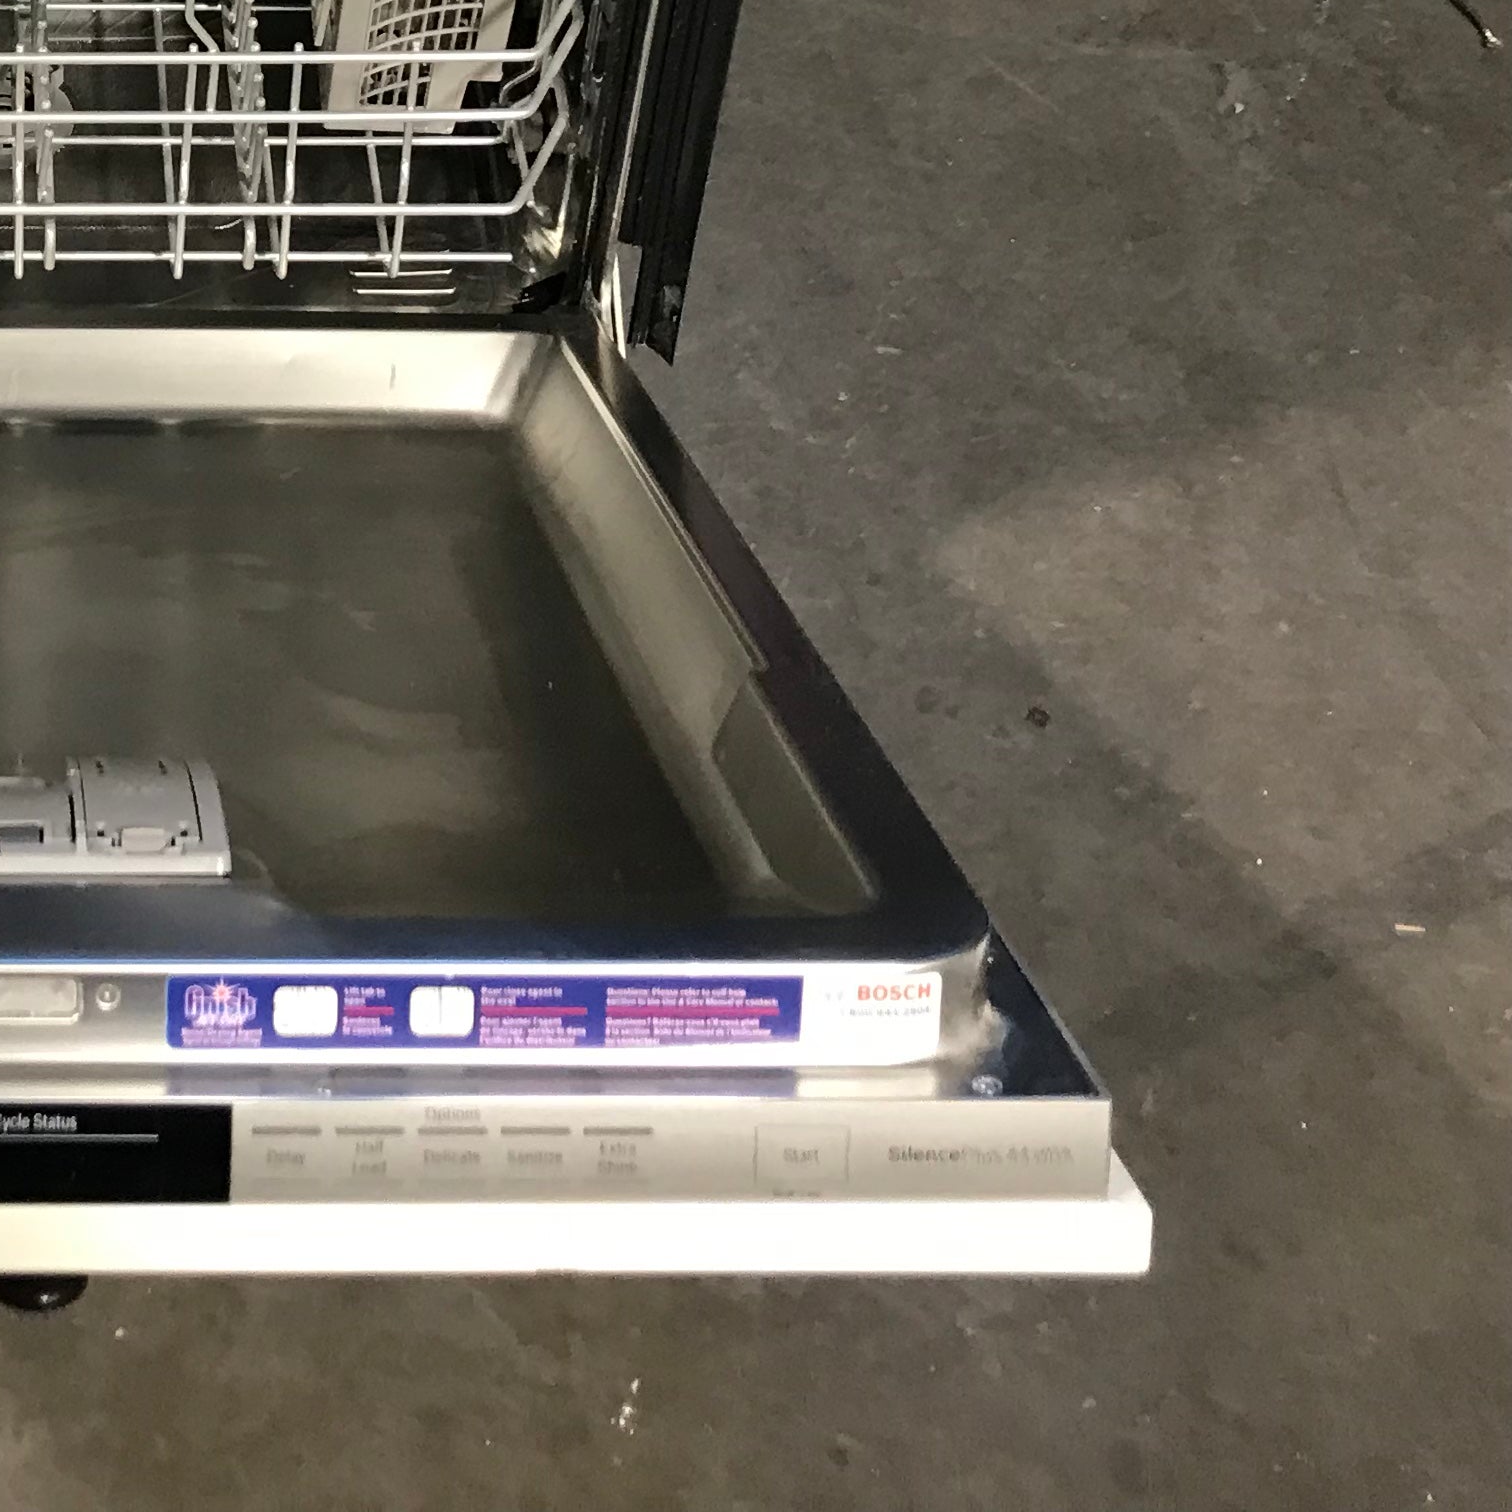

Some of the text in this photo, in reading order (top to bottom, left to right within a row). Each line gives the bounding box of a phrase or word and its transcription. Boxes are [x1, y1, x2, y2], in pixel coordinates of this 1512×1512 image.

[856, 982, 932, 1002] BOSCH
[32, 1111, 78, 1130] Status
[424, 1105, 482, 1122] Options
[265, 1148, 306, 1166] Delay
[423, 1148, 482, 1165] Delicate
[506, 1148, 564, 1165] Sanitize
[782, 1146, 821, 1165] Start
